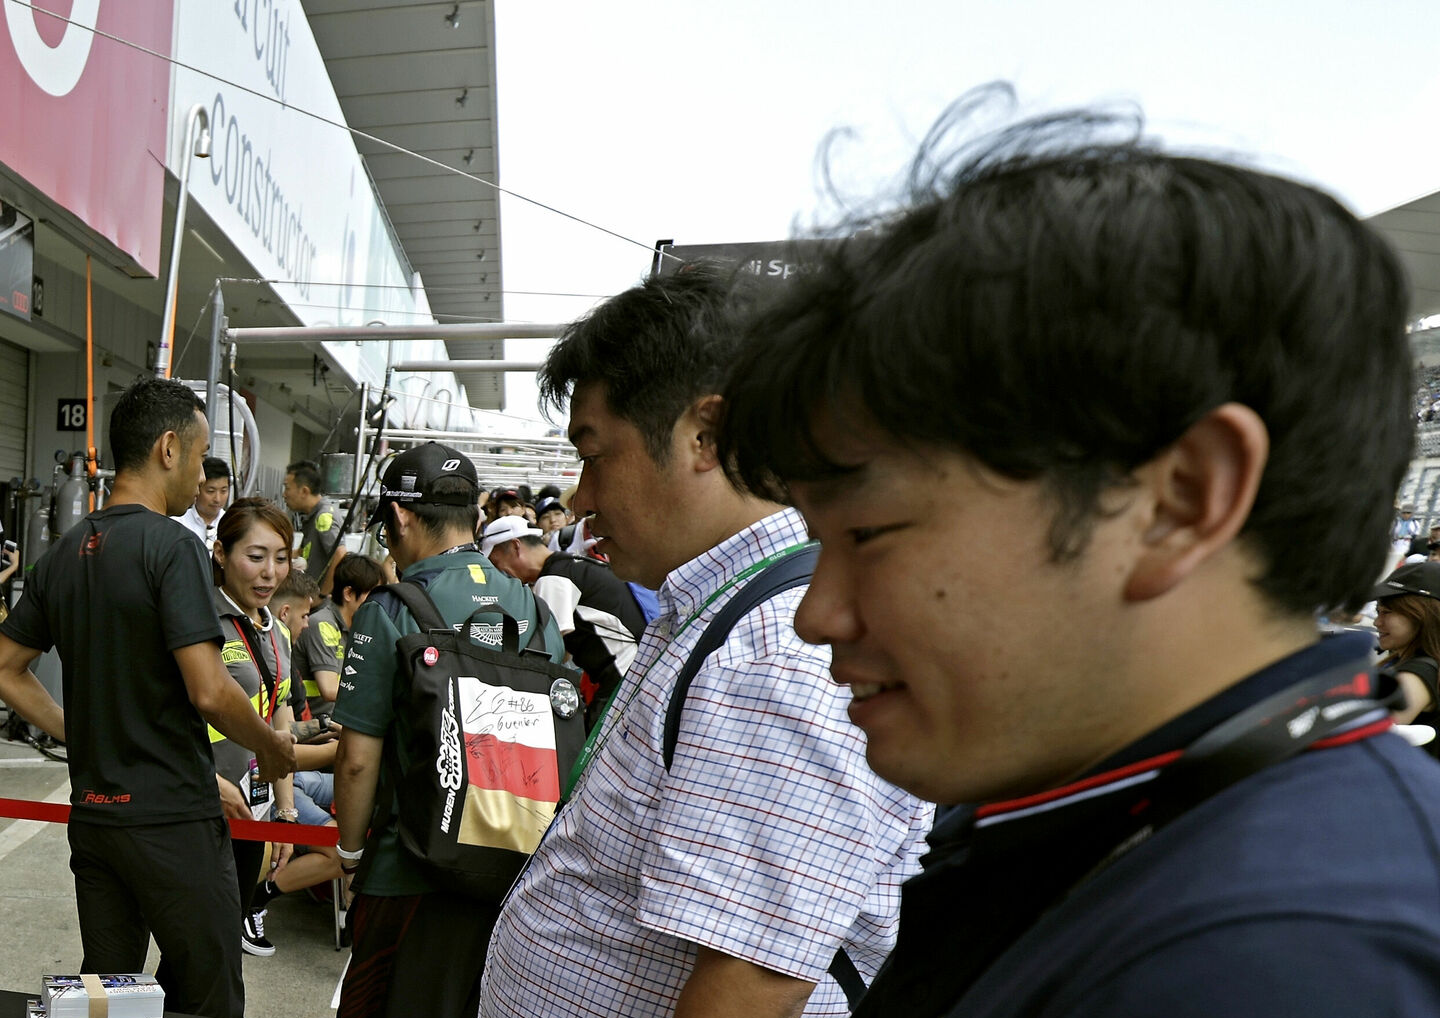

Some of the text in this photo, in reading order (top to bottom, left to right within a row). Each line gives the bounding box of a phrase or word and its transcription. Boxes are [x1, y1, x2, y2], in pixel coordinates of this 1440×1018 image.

[210, 92, 317, 298] Constructor
[61, 404, 85, 427] 18
[440, 790, 457, 833] MUGEN
